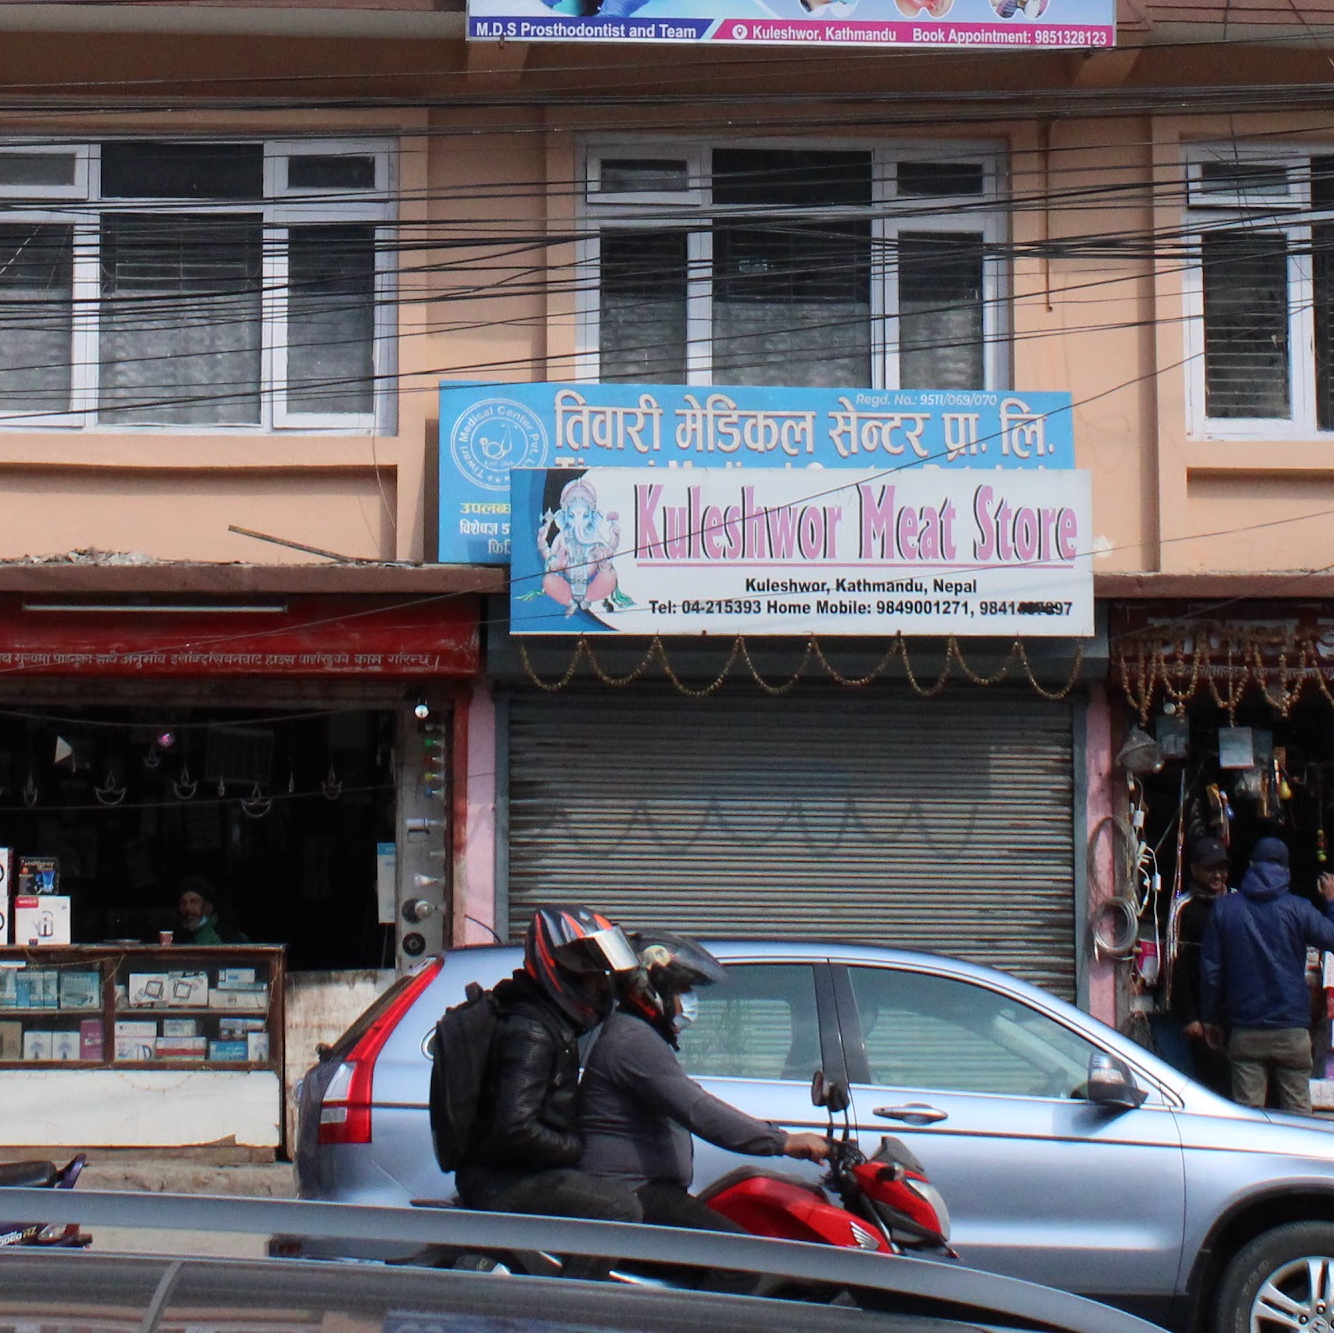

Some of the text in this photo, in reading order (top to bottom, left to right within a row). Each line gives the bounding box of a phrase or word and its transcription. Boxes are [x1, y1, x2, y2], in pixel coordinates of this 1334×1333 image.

[476, 22, 697, 39] M.D.S Prosthodontist and Team
[752, 25, 1107, 46] Kuleshwor, Kathmandu Book Appointment: 9851328123
[856, 394, 891, 407] Regd.
[555, 390, 664, 454] तिवारी
[675, 394, 815, 456] मेडिकल
[828, 397, 931, 458] सेन्टर
[634, 483, 1078, 561] Kuleshwor Meat Store
[745, 578, 977, 596] Kuleshwor, Kathmandu, Nepal
[649, 601, 677, 615] Tel:
[681, 601, 762, 615] 04-215393
[767, 601, 812, 615] Home
[816, 601, 872, 615] Mobile:
[876, 601, 975, 618] 9849001271,
